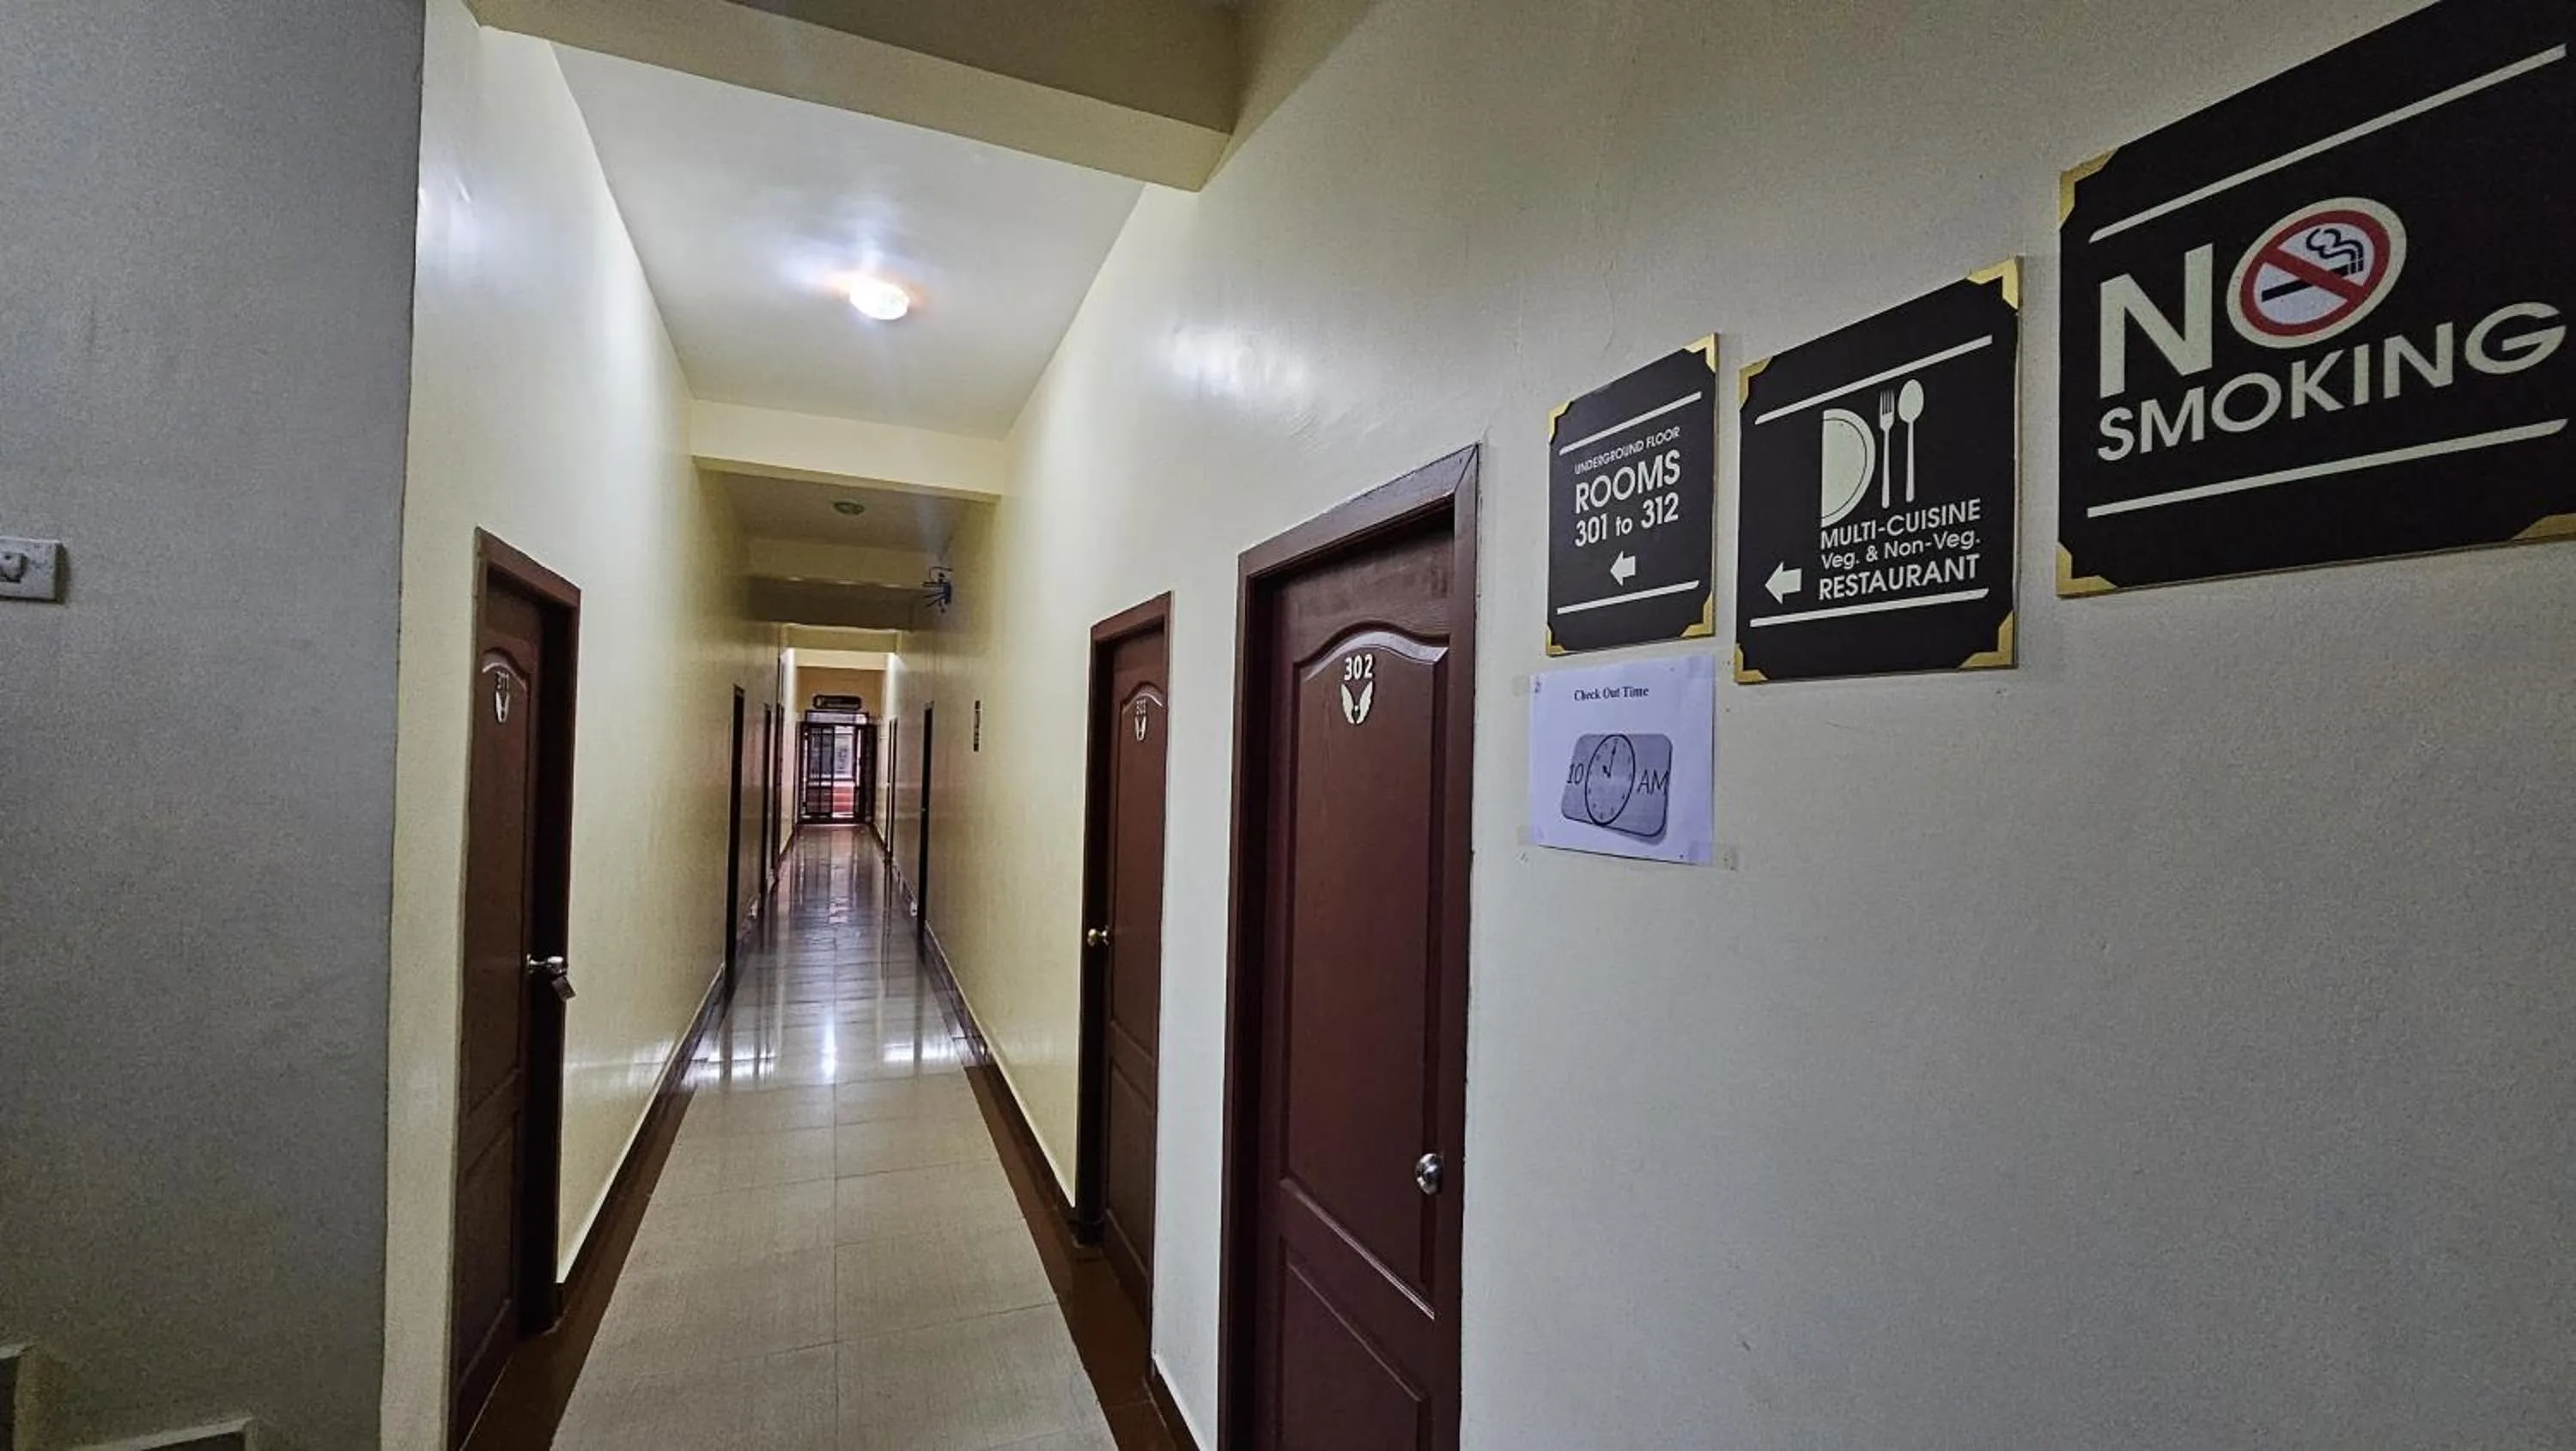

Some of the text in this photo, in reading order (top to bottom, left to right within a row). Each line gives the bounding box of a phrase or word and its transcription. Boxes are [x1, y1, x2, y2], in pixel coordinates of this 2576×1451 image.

[2098, 302, 2567, 462] SMOKING
[1574, 426, 1680, 475] UNDERGROUND FLOOR
[1575, 449, 1680, 514] ROOMS
[1574, 492, 1679, 547] 301 to 312
[1820, 498, 1981, 550] MULTI-CUISINE
[1821, 530, 1981, 570] Veg. & Non-Veg.
[1820, 554, 1980, 601] RESTAURANT
[1344, 653, 1373, 681] 302
[1574, 686, 1649, 701] Check Out Time
[1566, 762, 1668, 794] 10 AM
